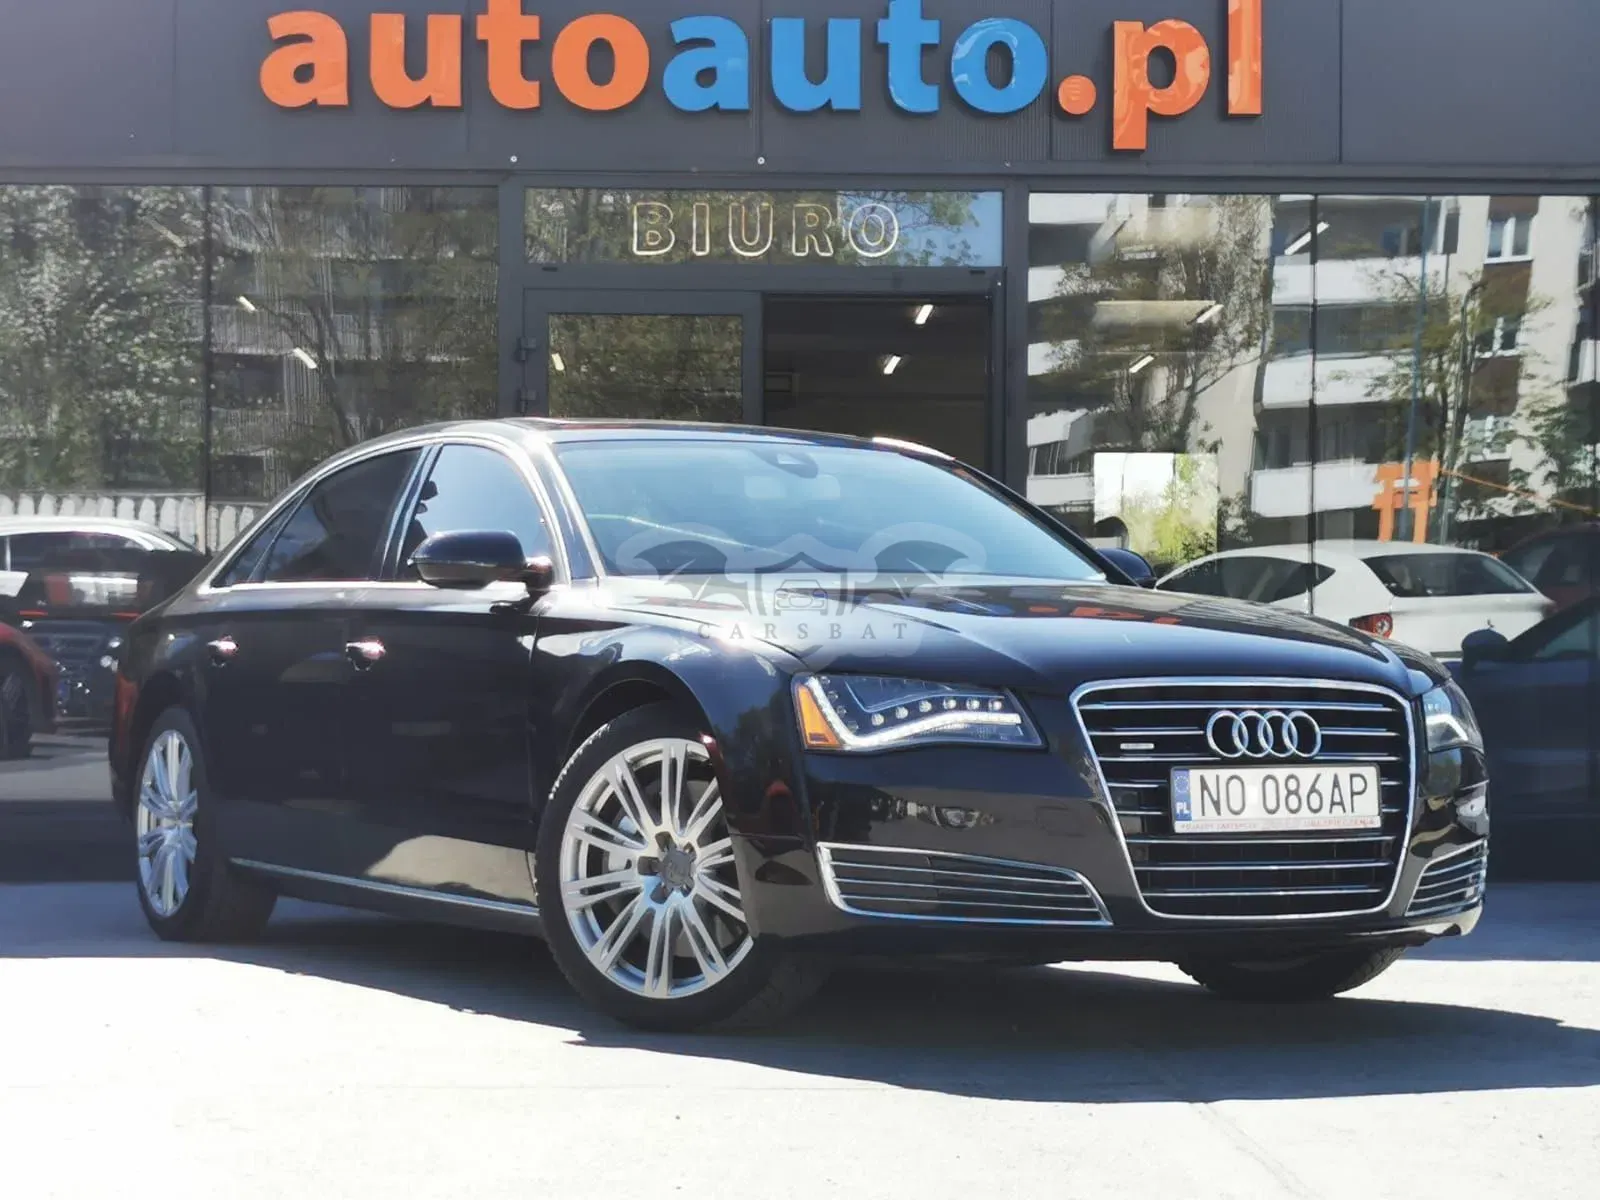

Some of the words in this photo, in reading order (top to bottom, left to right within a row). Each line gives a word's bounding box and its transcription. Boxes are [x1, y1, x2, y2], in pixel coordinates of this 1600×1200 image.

[260, 0, 1264, 150] autoauto.pl
[632, 202, 899, 257] BIURO
[1176, 801, 1189, 815] PL
[1199, 774, 1246, 816] NO
[1261, 773, 1368, 815] 086AP
